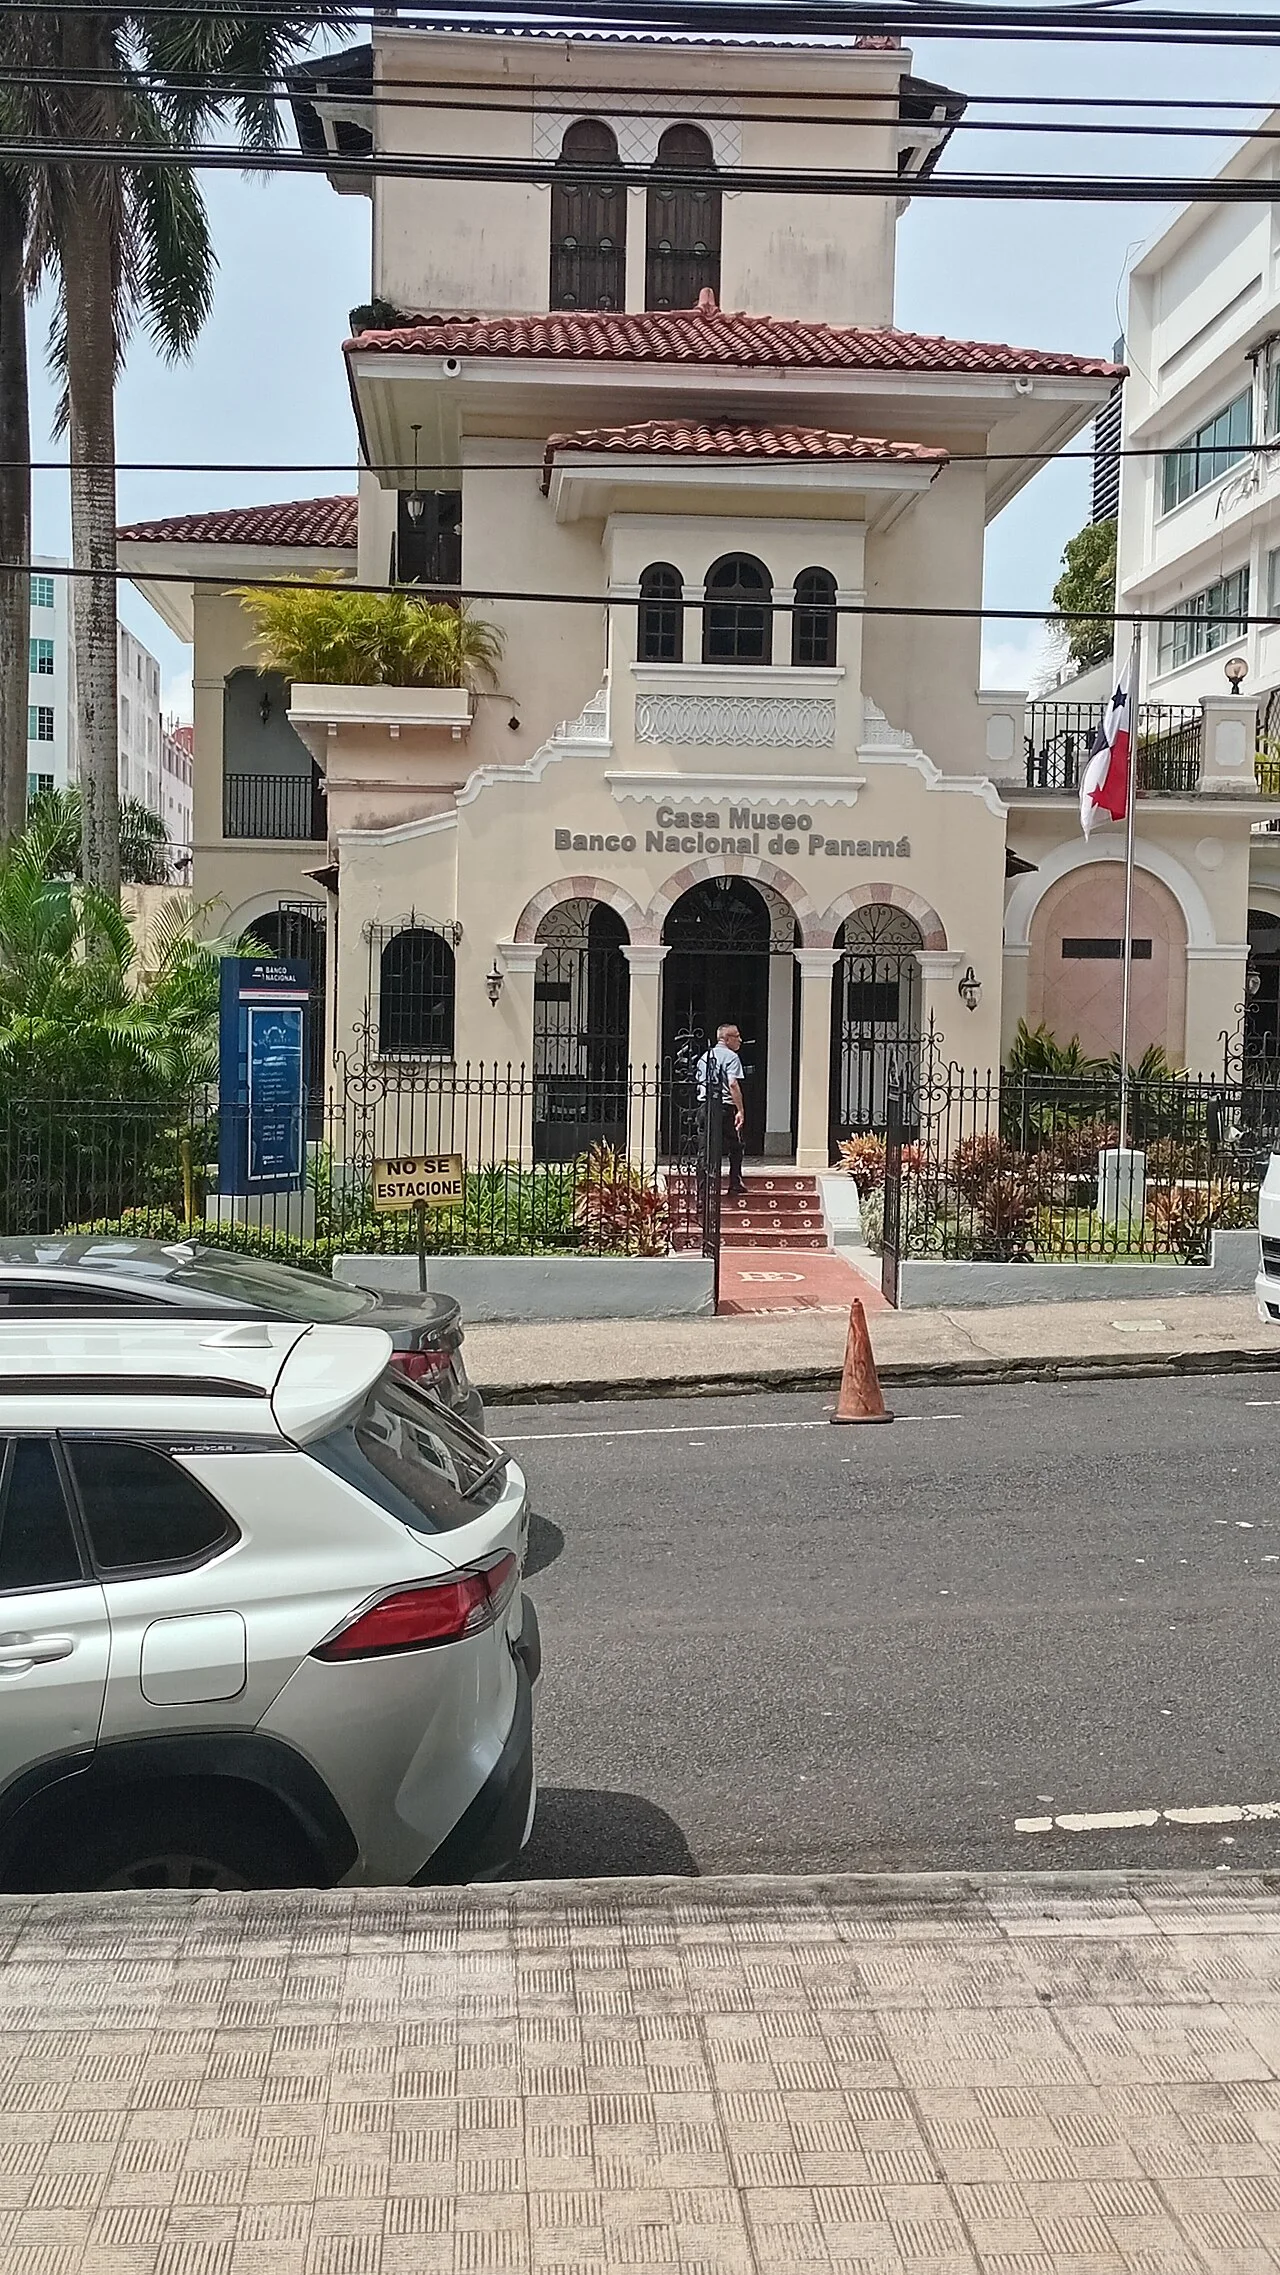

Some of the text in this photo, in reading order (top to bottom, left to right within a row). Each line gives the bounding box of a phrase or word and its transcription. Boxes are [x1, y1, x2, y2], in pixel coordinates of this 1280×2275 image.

[656, 805, 813, 832] Casa Museo
[554, 828, 911, 859] Banco Nacional de Panamá
[265, 966, 288, 974] BANCO
[265, 974, 297, 982] NACIONAL
[387, 1159, 450, 1176] NO SE
[377, 1180, 462, 1198] ESTACIONE
